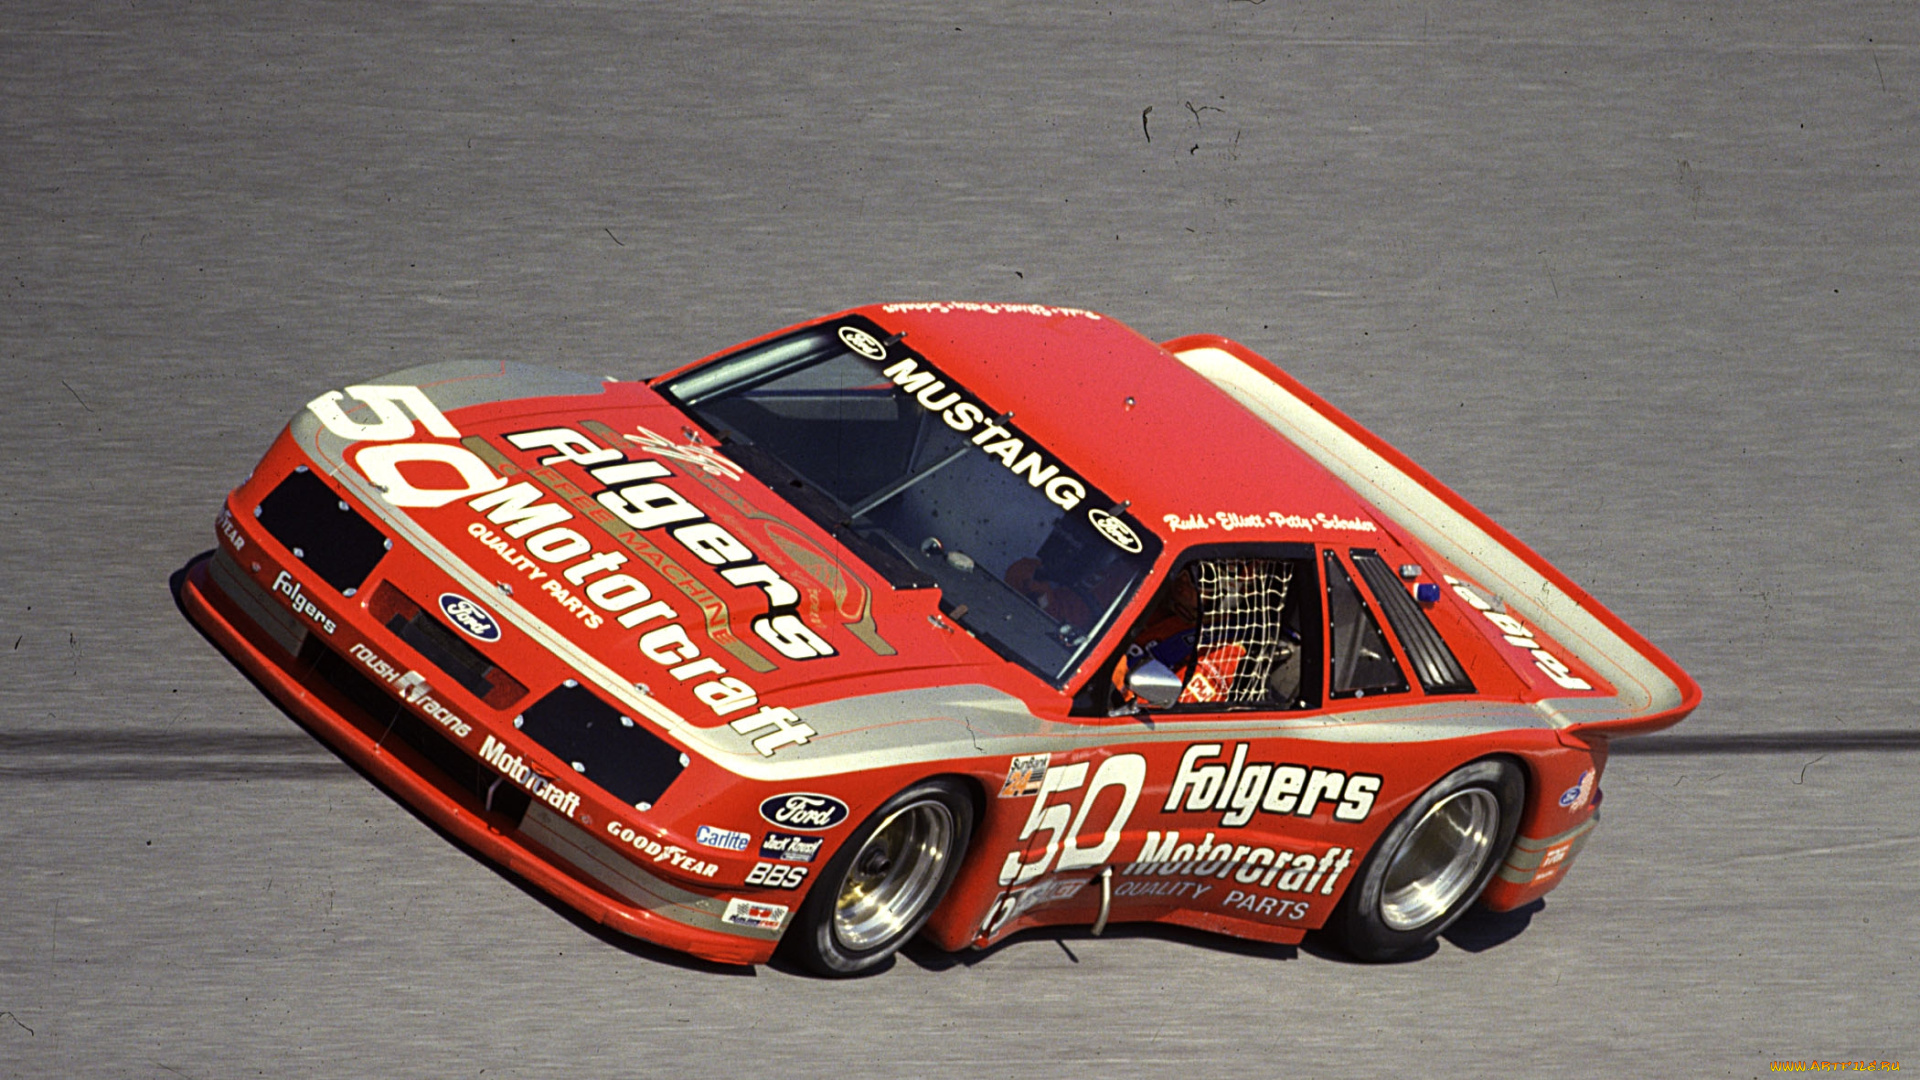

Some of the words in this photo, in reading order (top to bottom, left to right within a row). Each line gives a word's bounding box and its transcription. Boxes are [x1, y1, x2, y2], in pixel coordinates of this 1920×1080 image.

[306, 384, 509, 508] 50
[883, 358, 1087, 511] MUSTANG
[503, 426, 838, 660] Folgers
[1163, 513, 1209, 532] Rudd
[1215, 511, 1266, 531] Elliott
[1268, 511, 1313, 532] Petty
[271, 569, 337, 635] Folgers
[467, 522, 548, 581] QUALITY
[541, 578, 604, 630] PARTS
[618, 530, 738, 646] MACHINE
[446, 599, 492, 637] Ford
[468, 481, 819, 758] Motorcraft
[479, 734, 581, 818] Motorcraft
[1001, 770, 1032, 797] 24
[1163, 742, 1383, 829] Folgers
[696, 825, 749, 851] Carlite
[774, 796, 836, 827] Ford
[998, 752, 1147, 886] 50
[606, 820, 720, 878] GOODYEAR
[744, 861, 809, 889] BBS
[1121, 830, 1355, 896] Motorcraft
[1115, 880, 1212, 900] QUALITY
[1221, 889, 1310, 921] PARTS
